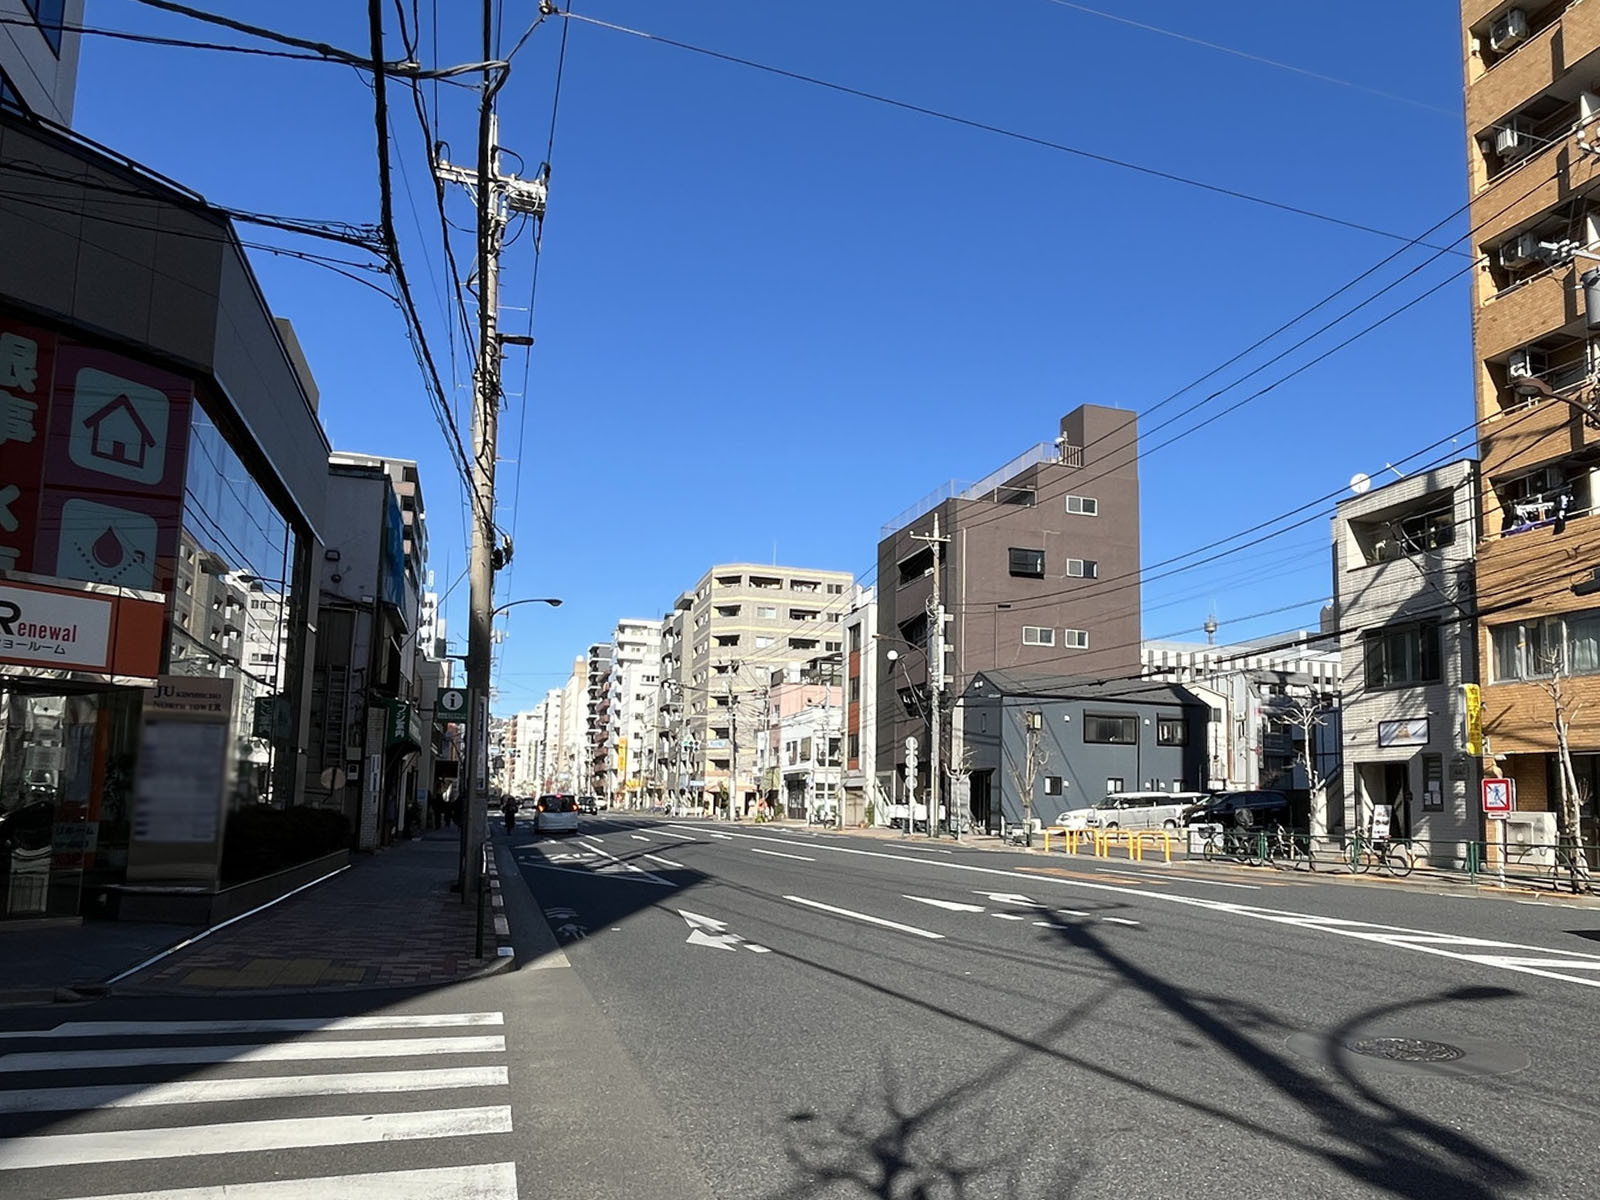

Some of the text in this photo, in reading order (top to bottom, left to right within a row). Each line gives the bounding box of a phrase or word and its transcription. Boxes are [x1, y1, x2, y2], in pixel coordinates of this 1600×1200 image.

[0, 600, 77, 642] Renewal
[0, 638, 66, 655] ョールーム
